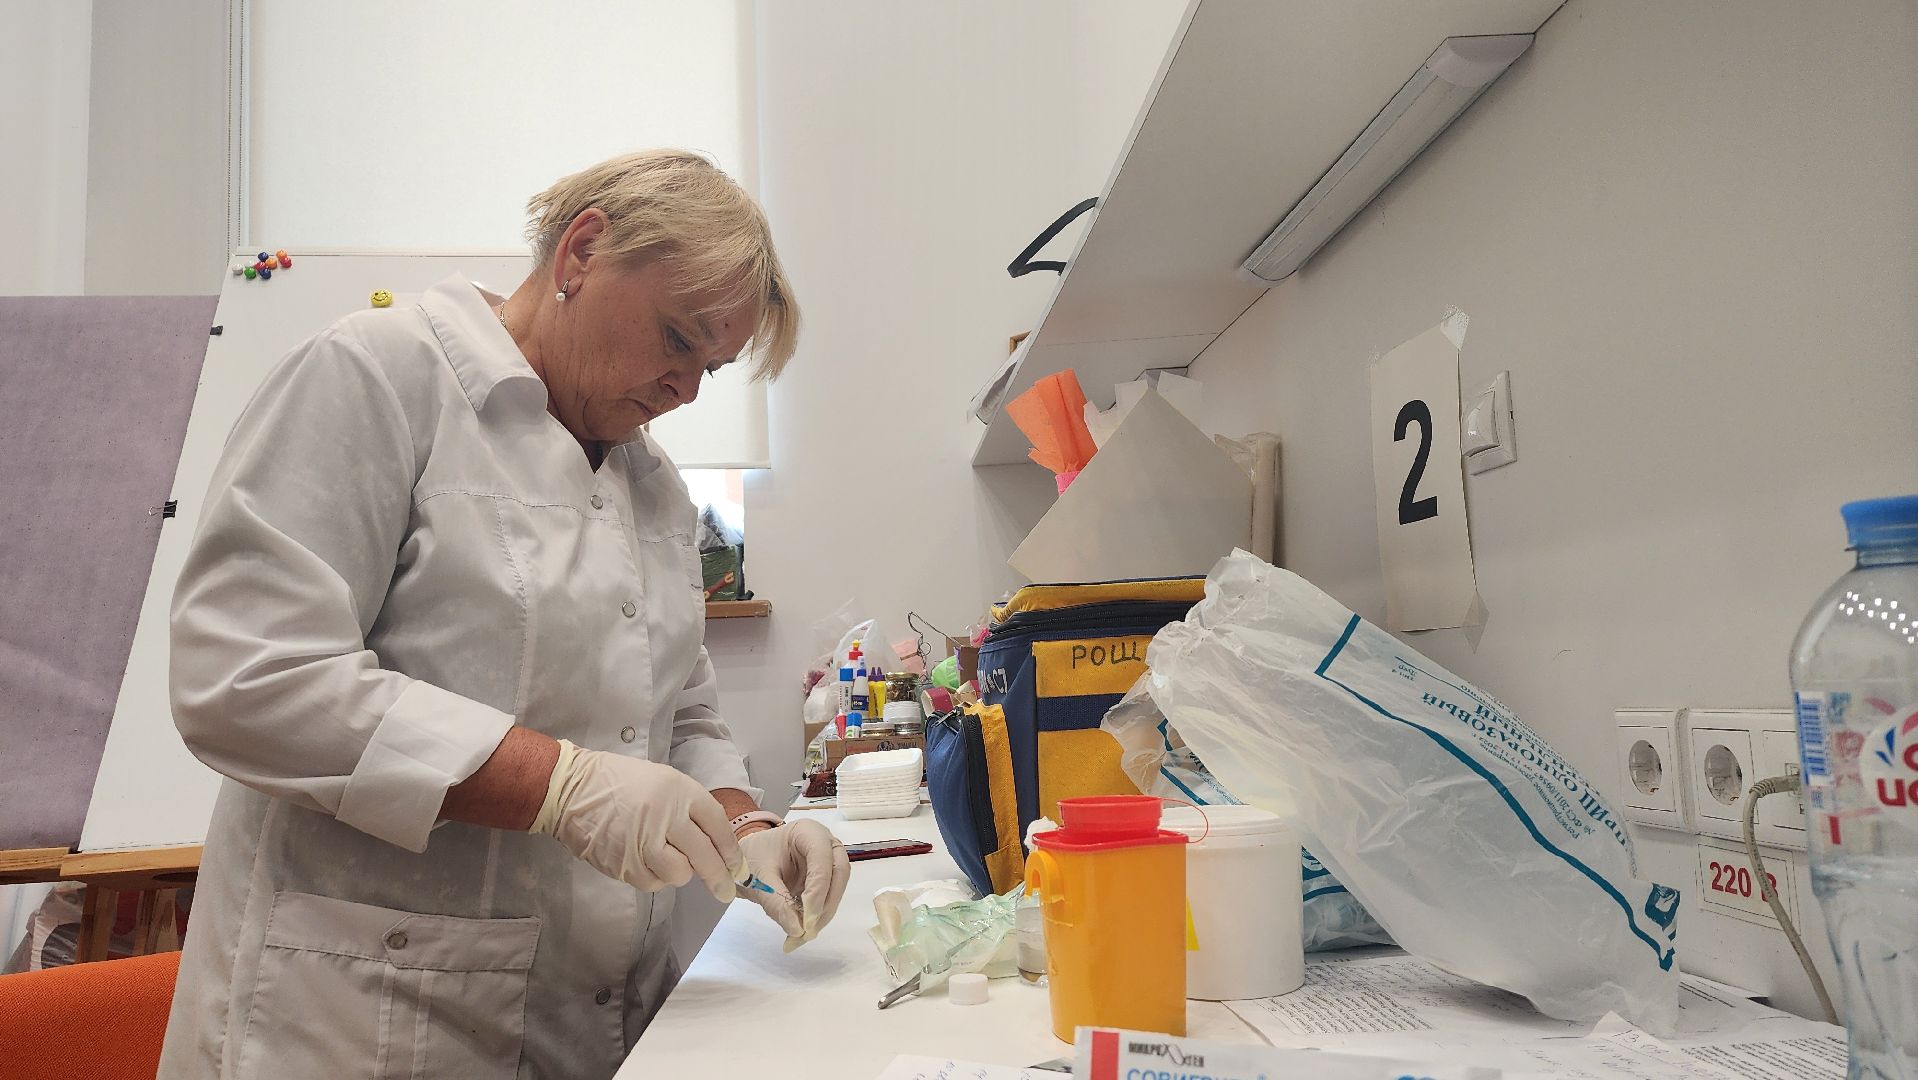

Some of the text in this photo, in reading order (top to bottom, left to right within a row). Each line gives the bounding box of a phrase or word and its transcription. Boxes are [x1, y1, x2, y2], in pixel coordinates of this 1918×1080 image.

[1394, 399, 1438, 525] 2
[1422, 691, 1578, 792] ОДНОРАЗОВЫЙ
[1578, 788, 1627, 847] ПРИЦ
[1709, 861, 1752, 898] 220
